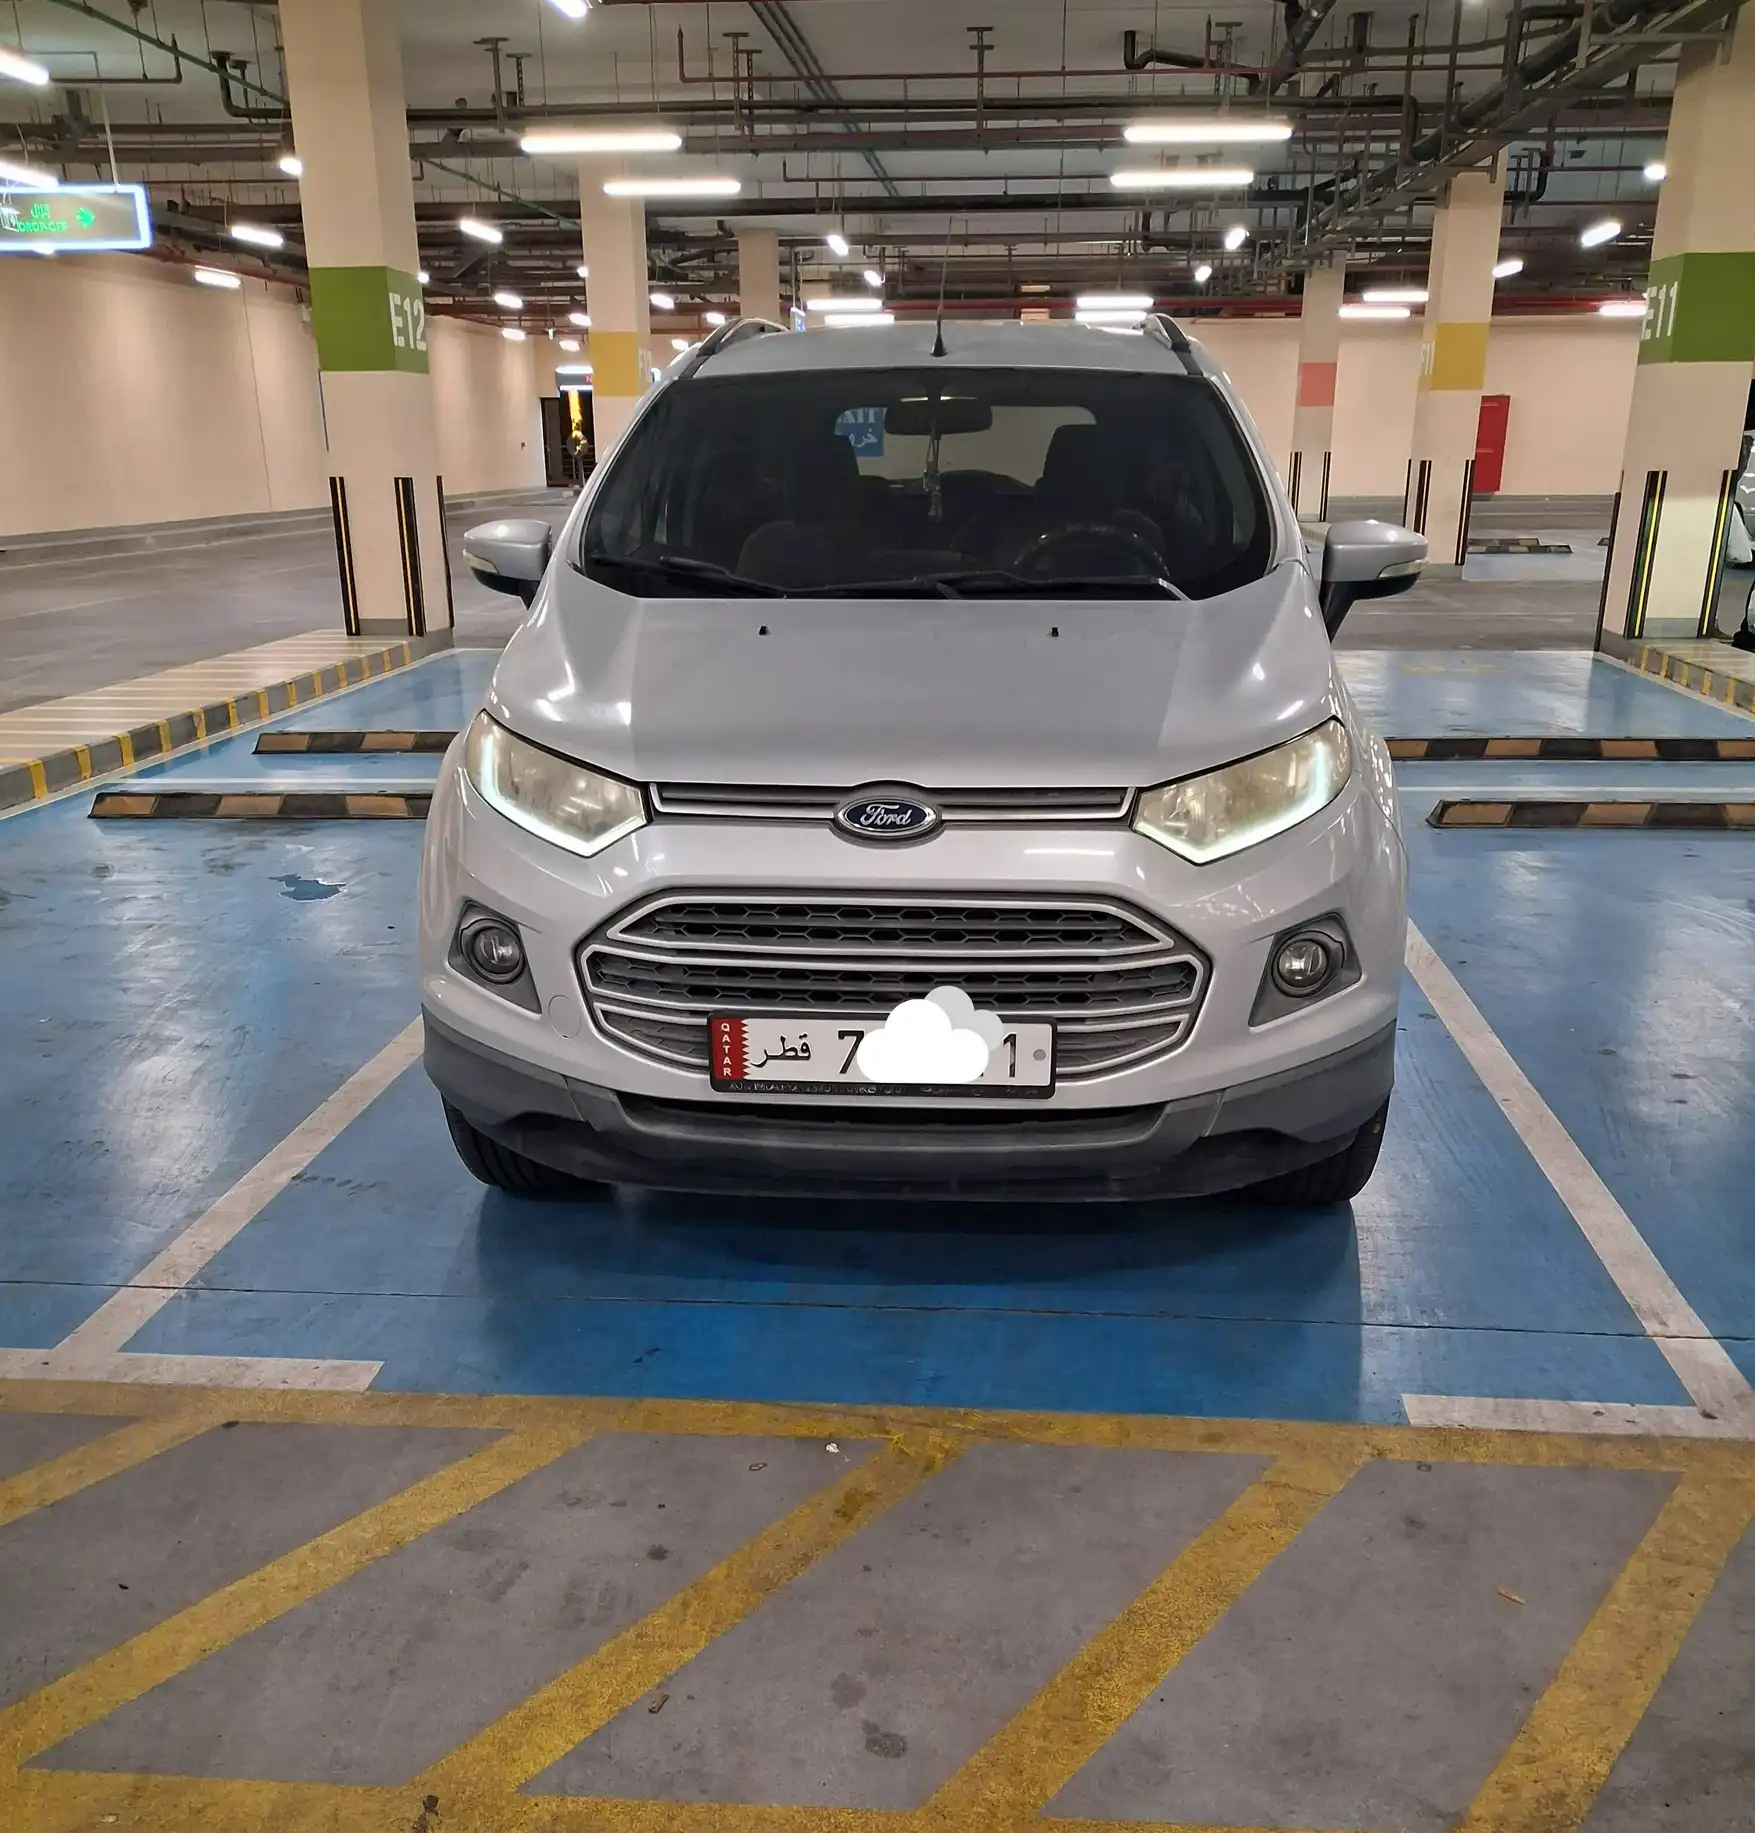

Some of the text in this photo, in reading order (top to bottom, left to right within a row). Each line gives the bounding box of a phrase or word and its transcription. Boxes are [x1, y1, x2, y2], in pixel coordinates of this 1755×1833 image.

[389, 292, 427, 351] E12
[1641, 281, 1678, 340] E11
[859, 803, 913, 826] Ford
[720, 1022, 732, 1077] QATAR
[751, 1032, 812, 1068] قطر
